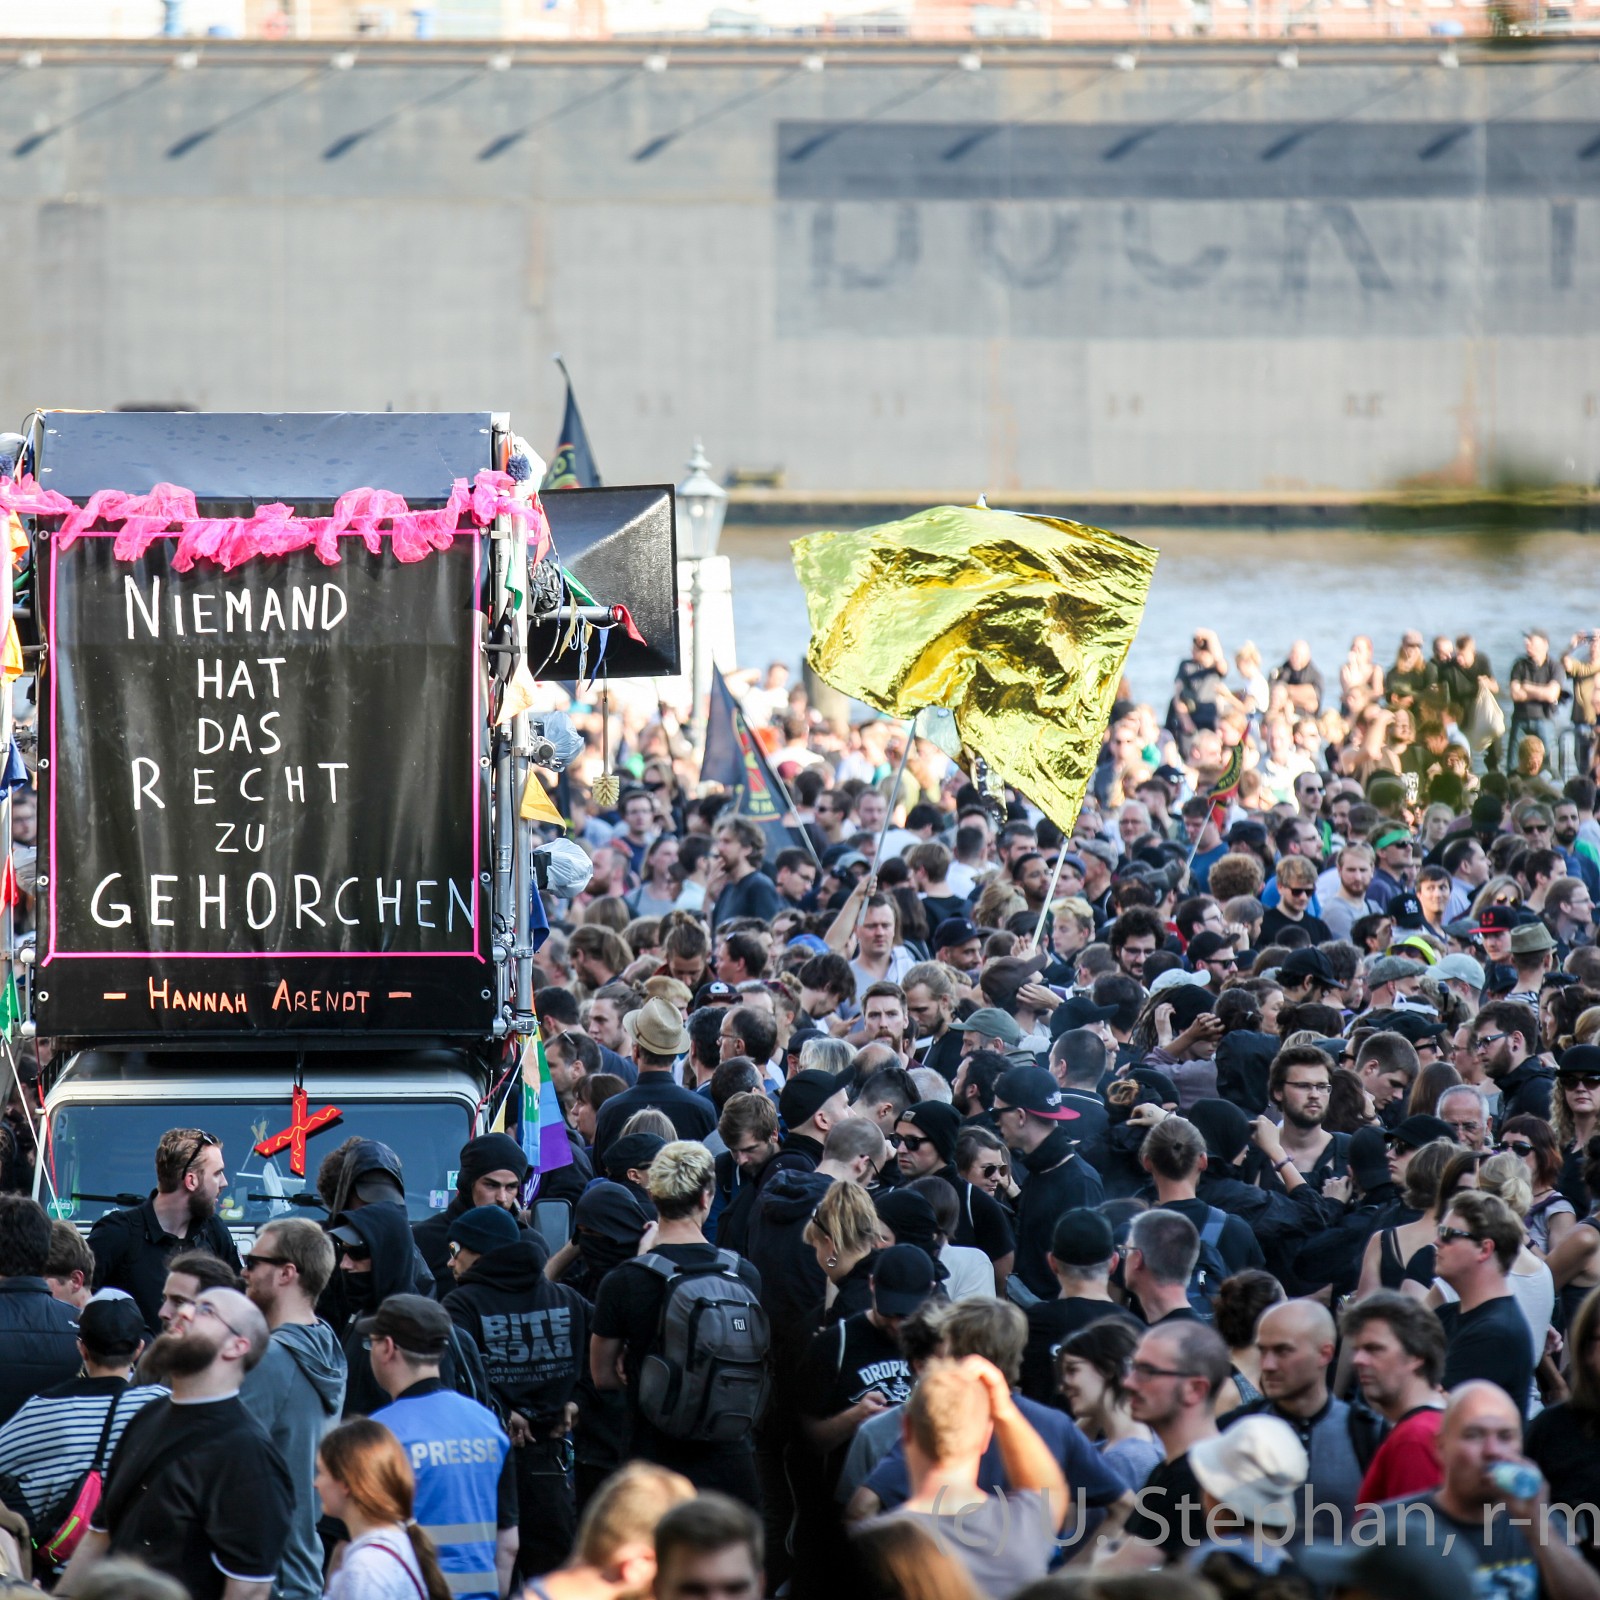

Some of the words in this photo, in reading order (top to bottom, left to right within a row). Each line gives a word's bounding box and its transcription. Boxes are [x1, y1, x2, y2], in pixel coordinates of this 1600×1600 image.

[125, 575, 348, 640] NIEMAND
[197, 657, 287, 699] HAT
[198, 711, 282, 755] DAS
[131, 757, 349, 810] RECHT
[215, 822, 265, 853] ZU
[90, 872, 476, 933] GEHORCHEN
[148, 976, 248, 1014] HANNAH
[271, 978, 370, 1014] ARENDT
[481, 1307, 571, 1341] BITE
[488, 1375, 505, 1384] OR
[489, 1366, 502, 1375] OR
[411, 1438, 498, 1469] PRESSE
